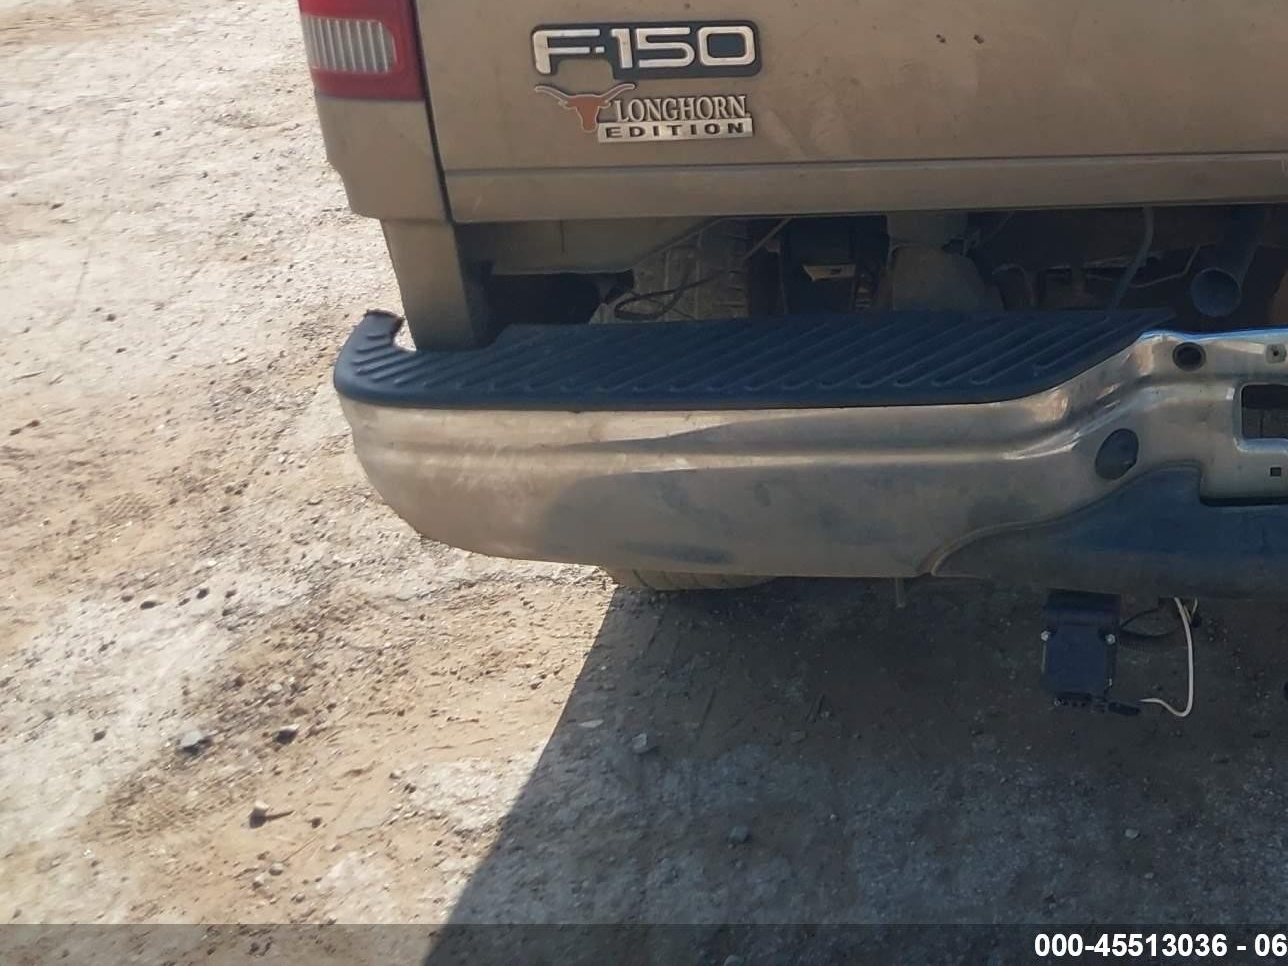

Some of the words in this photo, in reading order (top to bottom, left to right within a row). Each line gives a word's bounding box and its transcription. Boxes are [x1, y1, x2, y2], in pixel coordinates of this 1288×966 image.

[532, 25, 757, 75] F-150
[613, 94, 749, 123] LONGHORN
[605, 122, 745, 139] EDITION
